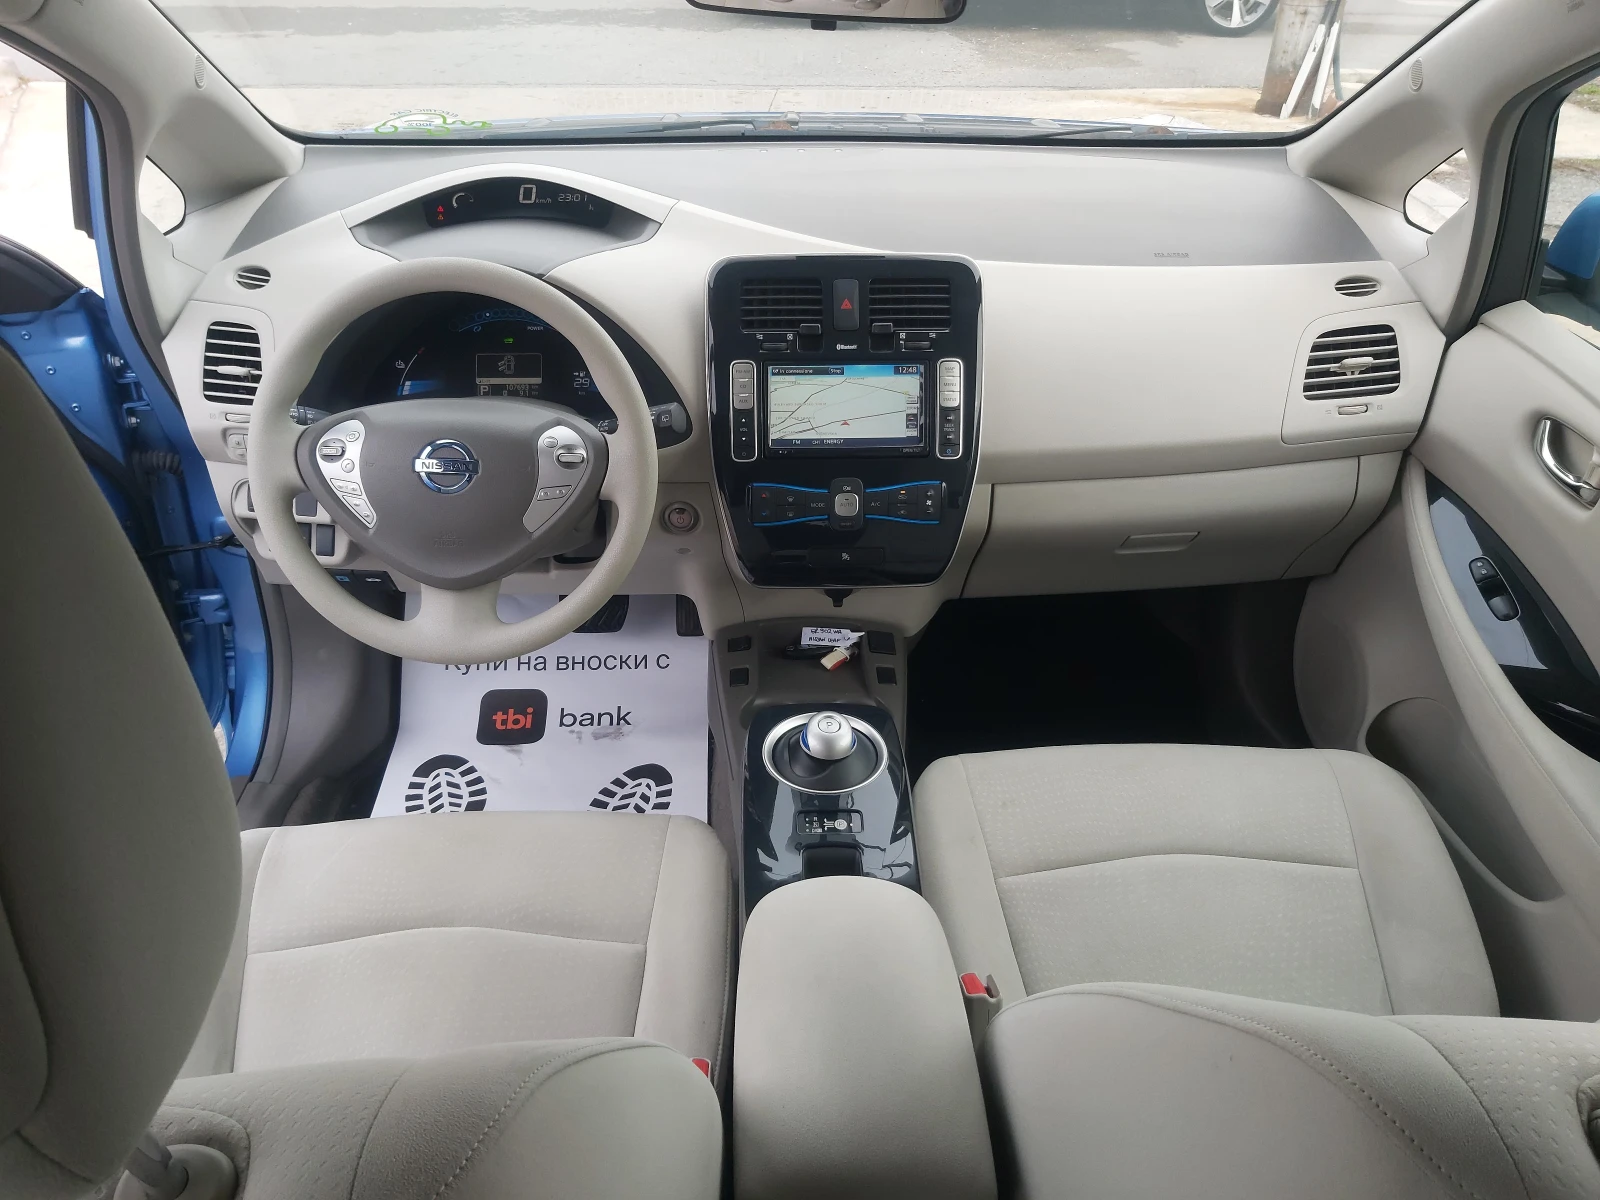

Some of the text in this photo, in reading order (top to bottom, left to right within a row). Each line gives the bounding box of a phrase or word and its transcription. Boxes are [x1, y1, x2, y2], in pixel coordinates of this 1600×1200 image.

[518, 184, 552, 205] 0 km/h
[558, 193, 588, 202] 23:01
[573, 378, 590, 388] 29
[480, 385, 489, 396] P
[421, 461, 473, 471] NISSAN
[517, 655, 547, 671] на
[556, 653, 649, 671] вноски
[656, 653, 670, 669] с
[492, 706, 633, 730] tbi bank
